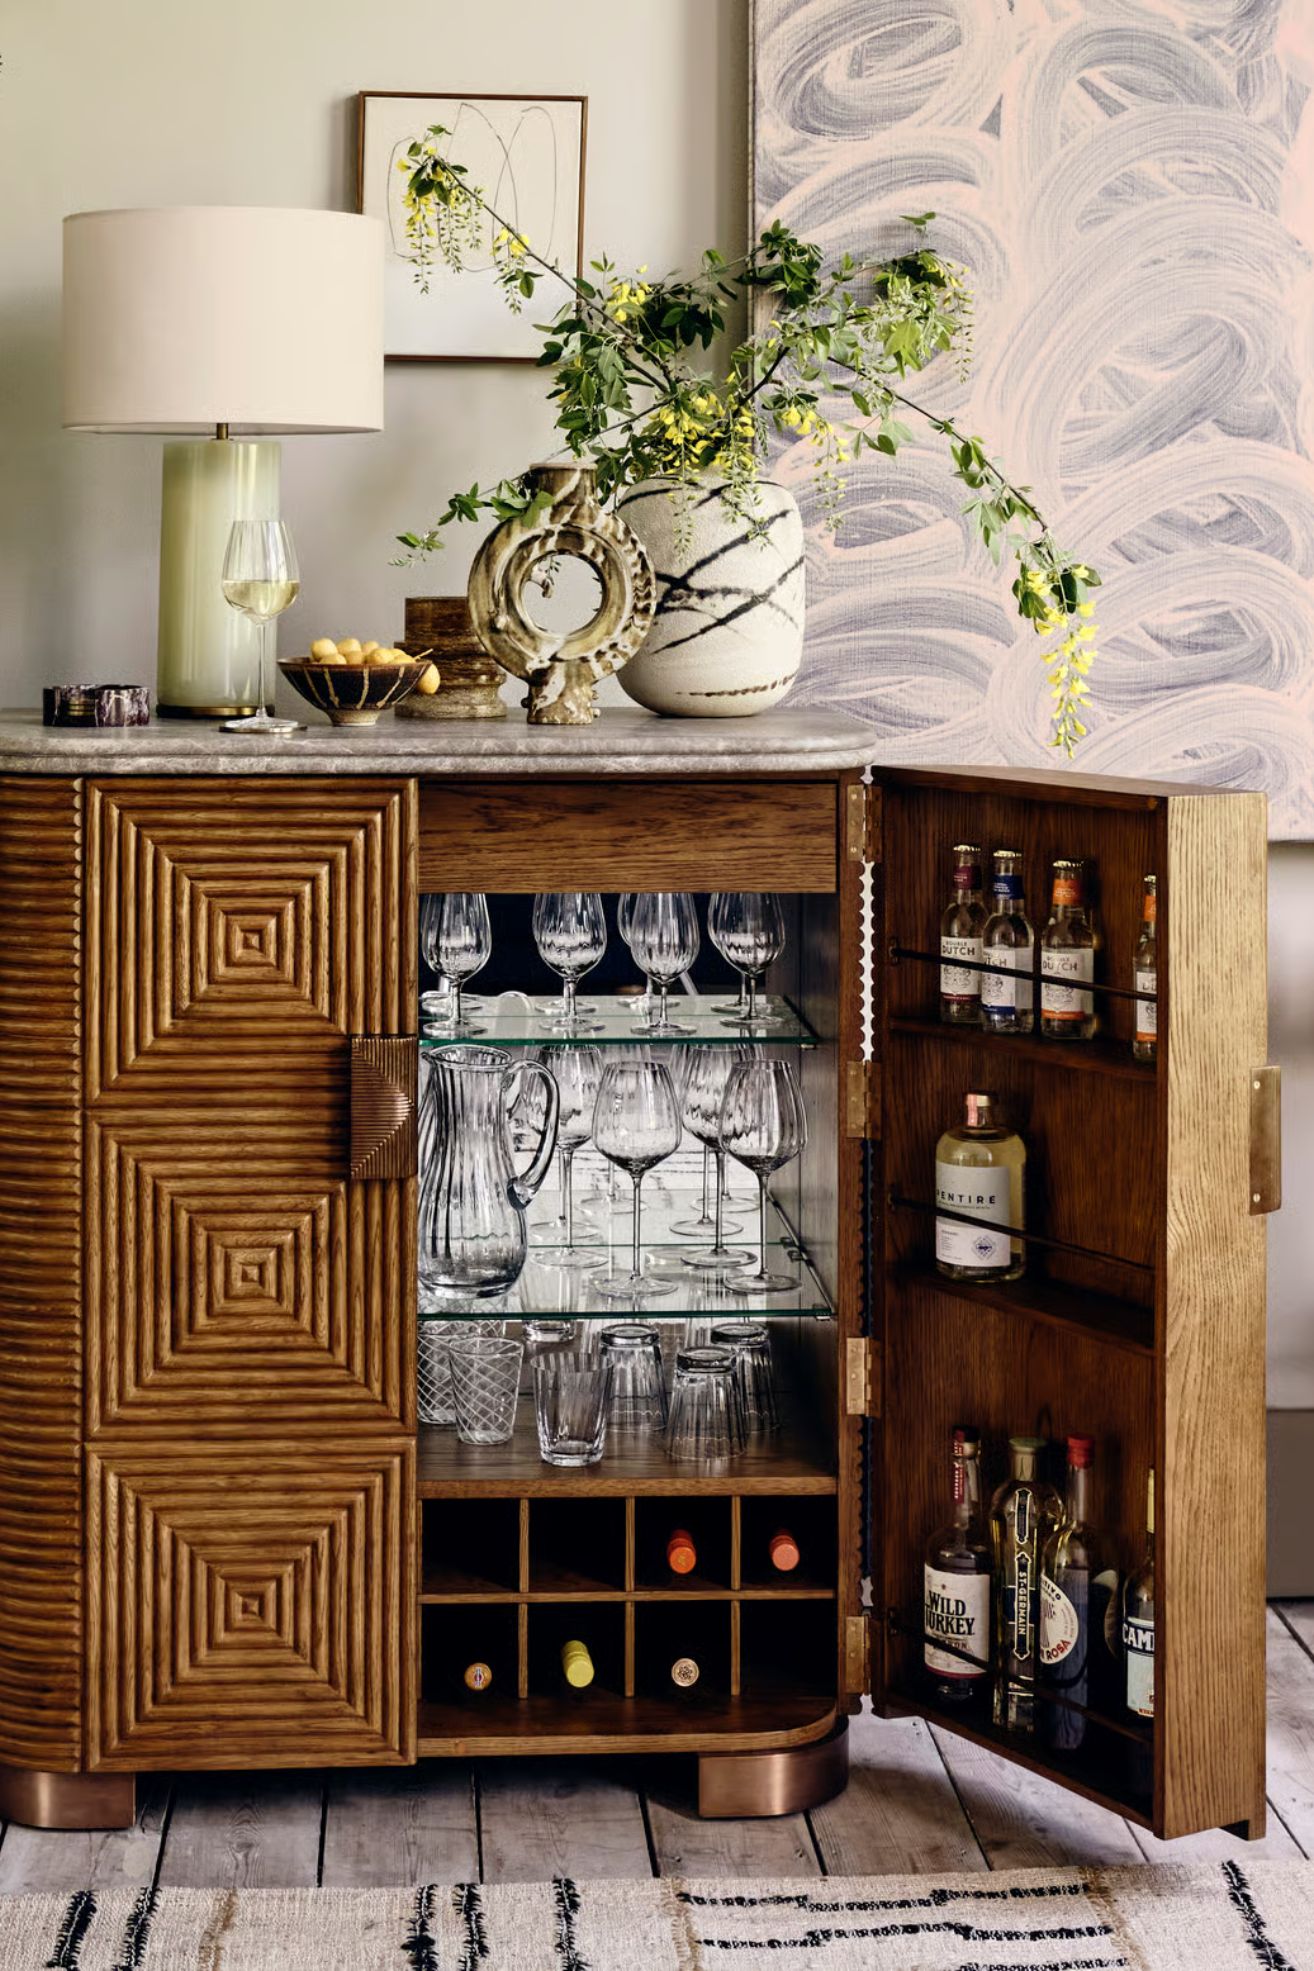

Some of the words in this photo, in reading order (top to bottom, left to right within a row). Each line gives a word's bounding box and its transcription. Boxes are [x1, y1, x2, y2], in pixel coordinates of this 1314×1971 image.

[942, 945, 975, 956] DUTCH
[1042, 960, 1078, 971] DUCH
[928, 1590, 966, 1616] WILD
[1046, 1639, 1072, 1661] ROSA
